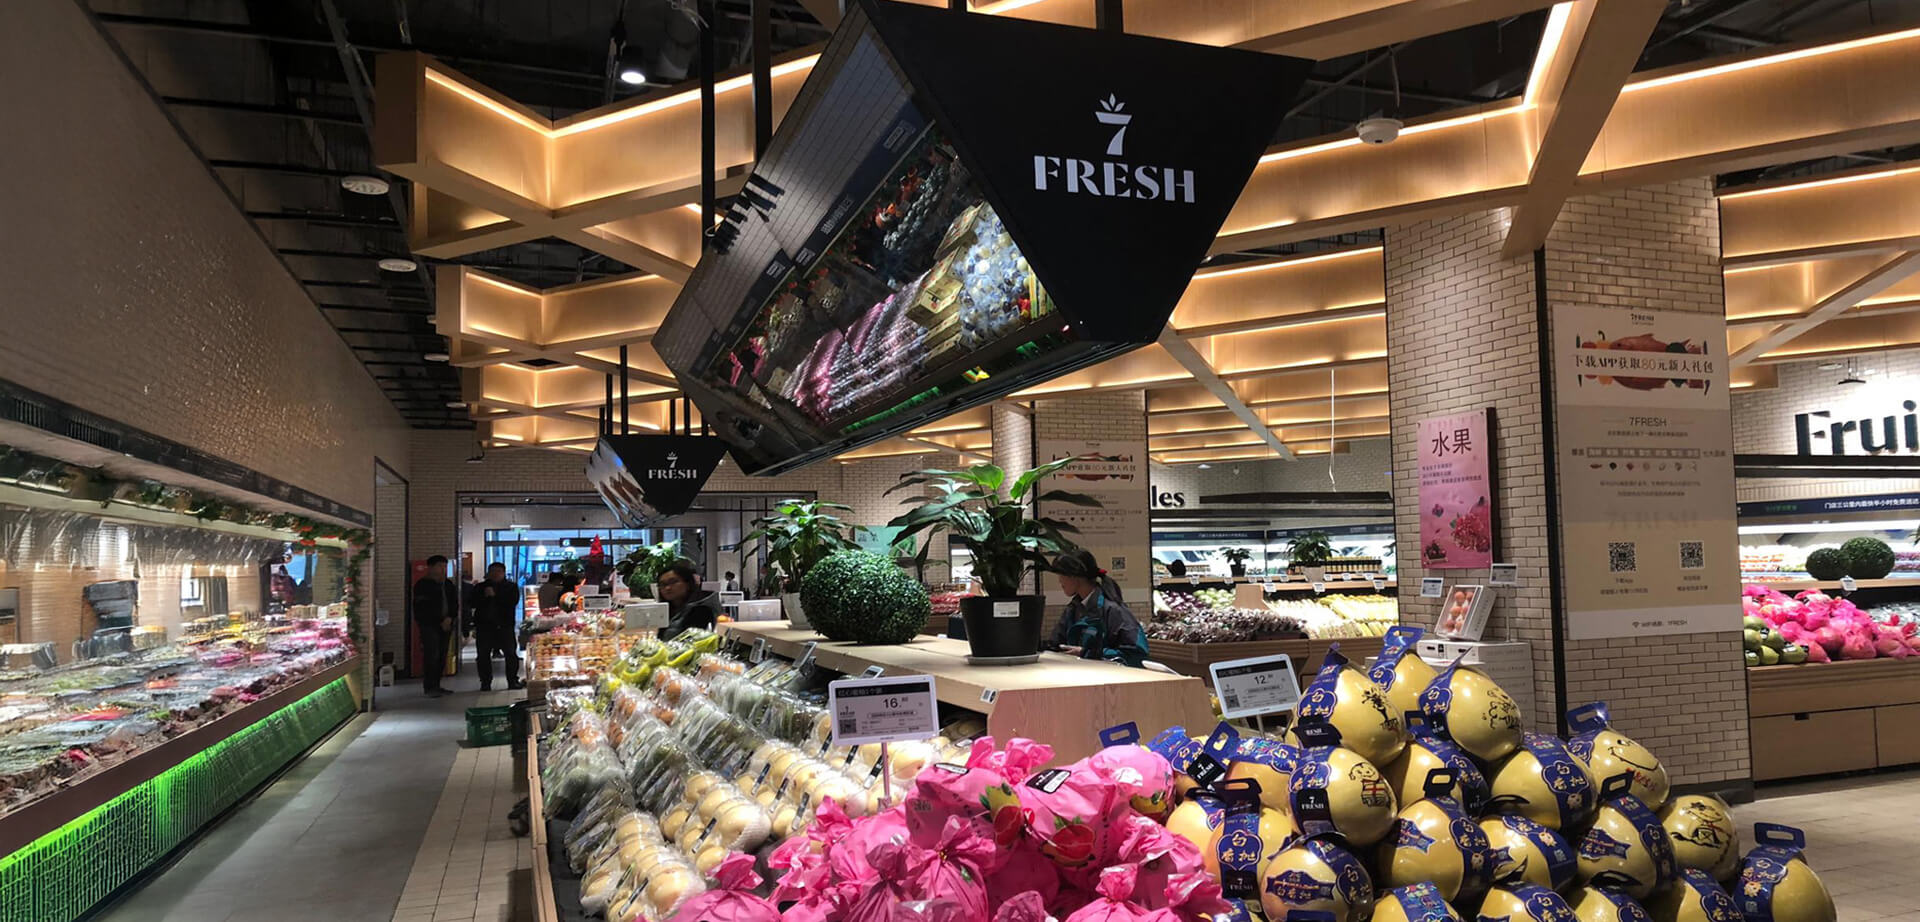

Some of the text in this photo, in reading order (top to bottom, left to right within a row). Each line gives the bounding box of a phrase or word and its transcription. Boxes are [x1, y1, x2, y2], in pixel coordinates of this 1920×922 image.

[1095, 111, 1132, 156] 7
[1033, 155, 1196, 204] FRESH
[1628, 416, 1668, 427] 7FRESH
[1431, 427, 1472, 458] 水果
[666, 455, 679, 469] 7
[648, 469, 698, 479] FRESH
